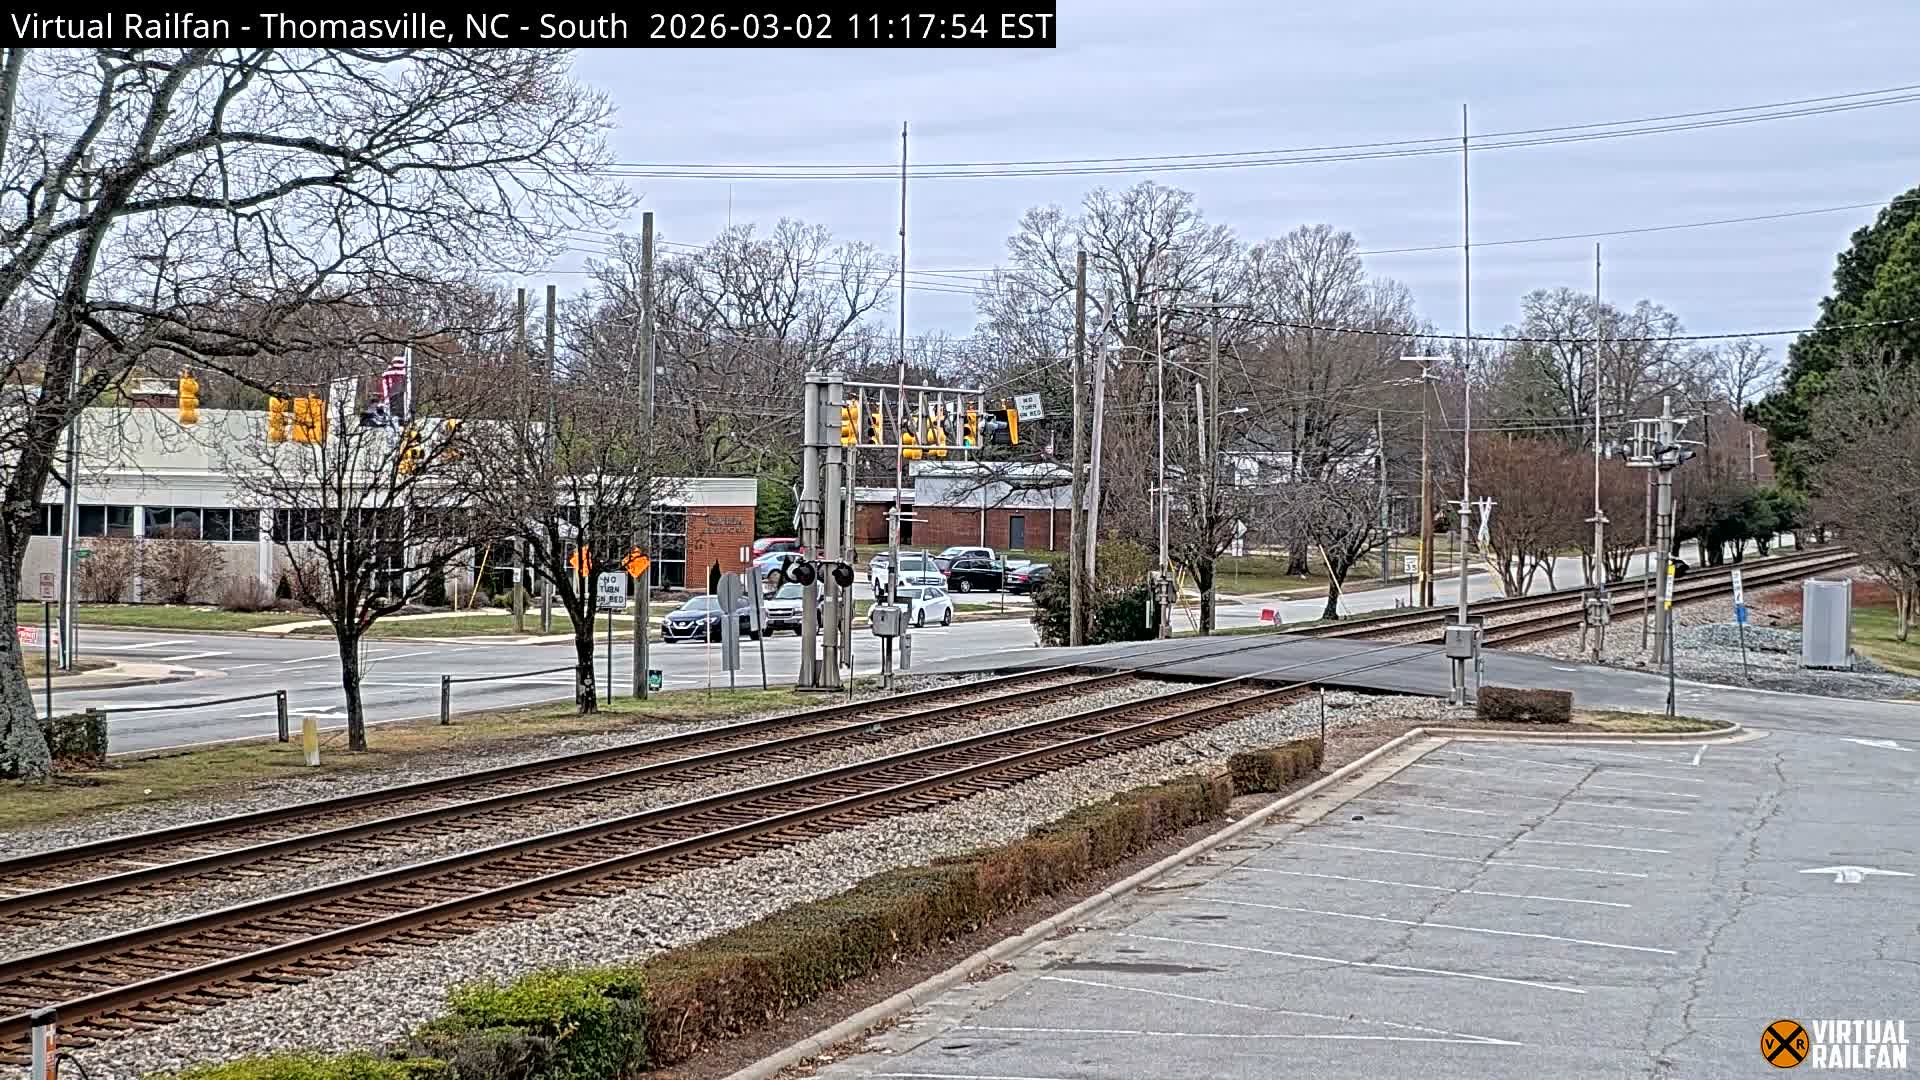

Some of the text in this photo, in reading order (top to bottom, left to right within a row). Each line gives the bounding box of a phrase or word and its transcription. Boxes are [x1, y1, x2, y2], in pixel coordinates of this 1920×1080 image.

[603, 576, 617, 584] NO
[600, 585, 620, 593] TURN
[609, 595, 624, 603] RED
